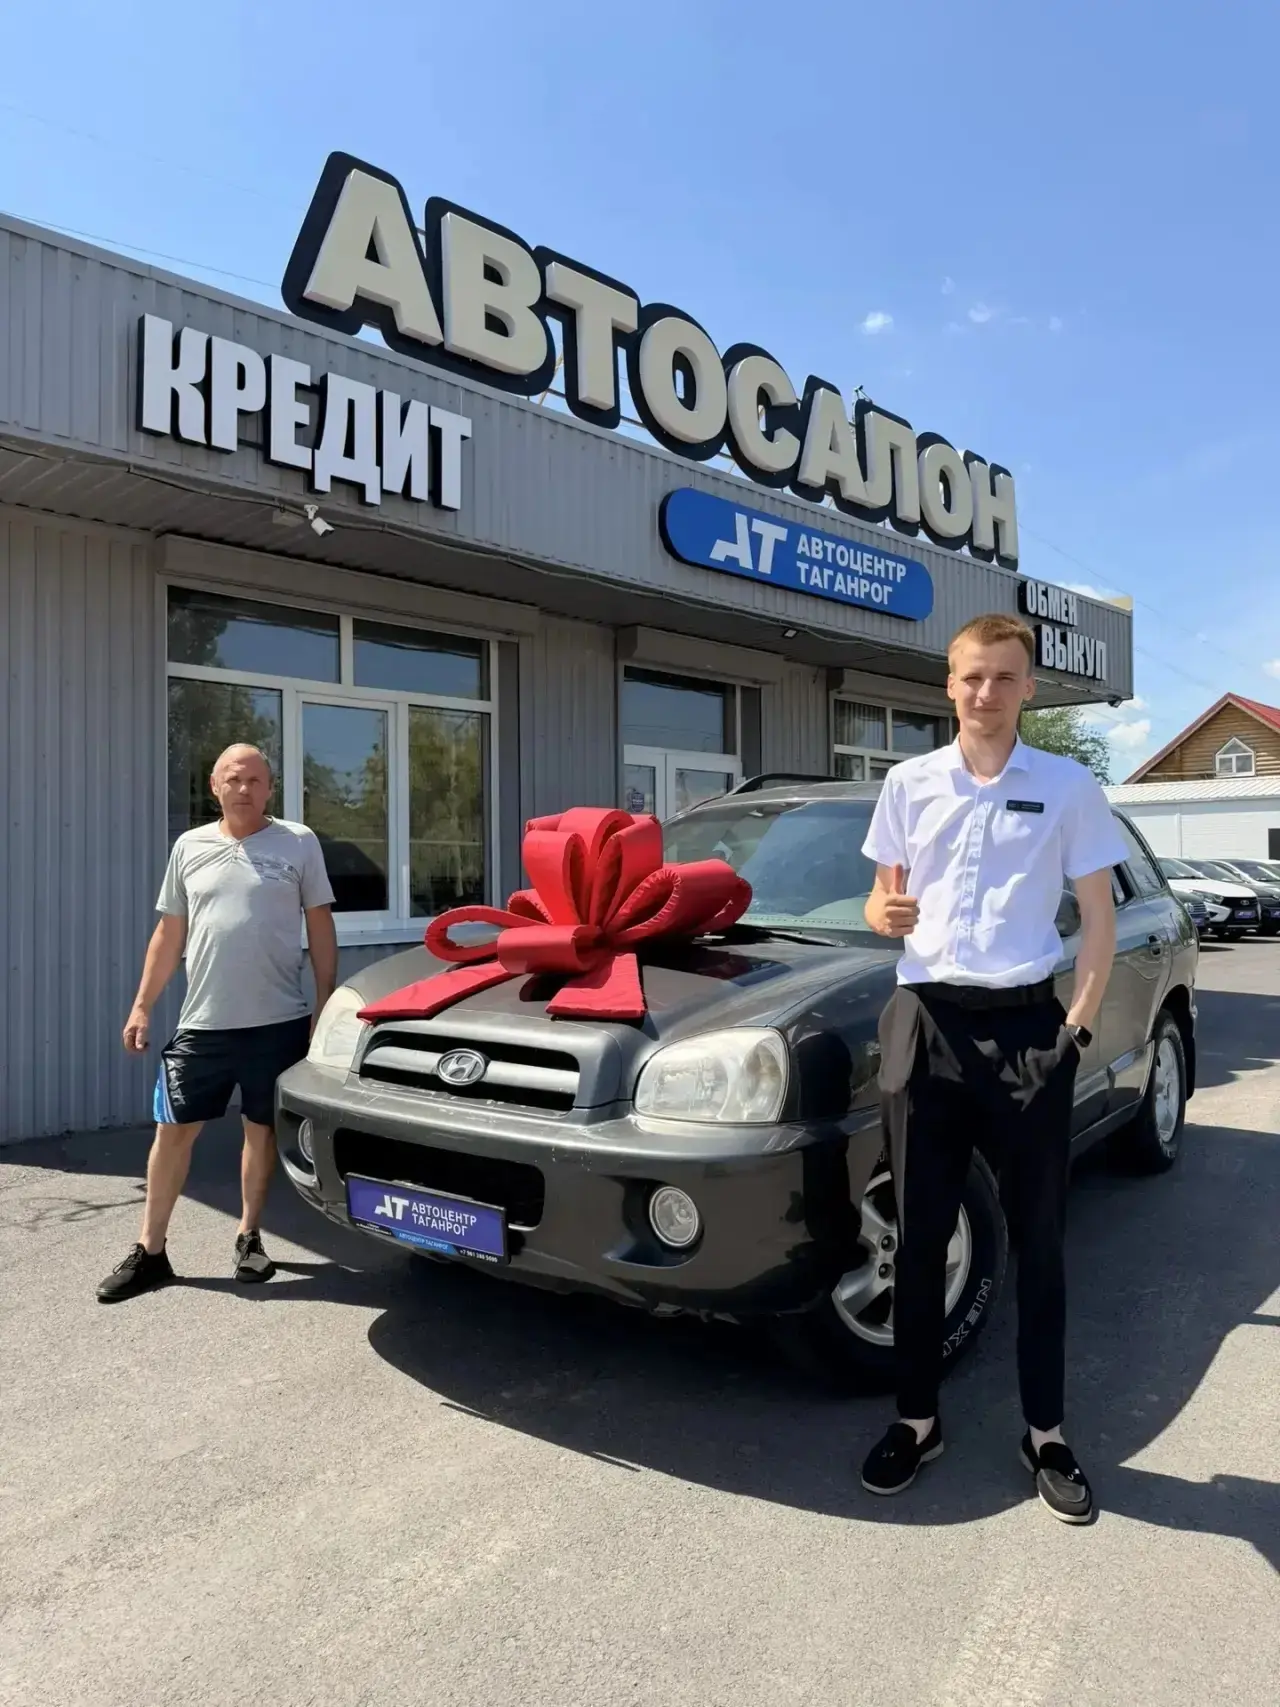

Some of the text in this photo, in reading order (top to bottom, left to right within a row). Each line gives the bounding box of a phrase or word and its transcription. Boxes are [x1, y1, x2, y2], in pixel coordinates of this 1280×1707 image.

[302, 167, 1019, 561] АВТОСАЛОН
[140, 313, 473, 510] КРЕДИТ
[796, 533, 907, 583] АВТОЦЕНТР
[796, 560, 893, 605] ТАГАНРОГ
[1025, 580, 1078, 626] ОБМЕН
[1041, 623, 1107, 681] ВЫКУП
[411, 1201, 477, 1227] АВТОЦЕНТР
[411, 1212, 469, 1237] ТАГАНРОГ
